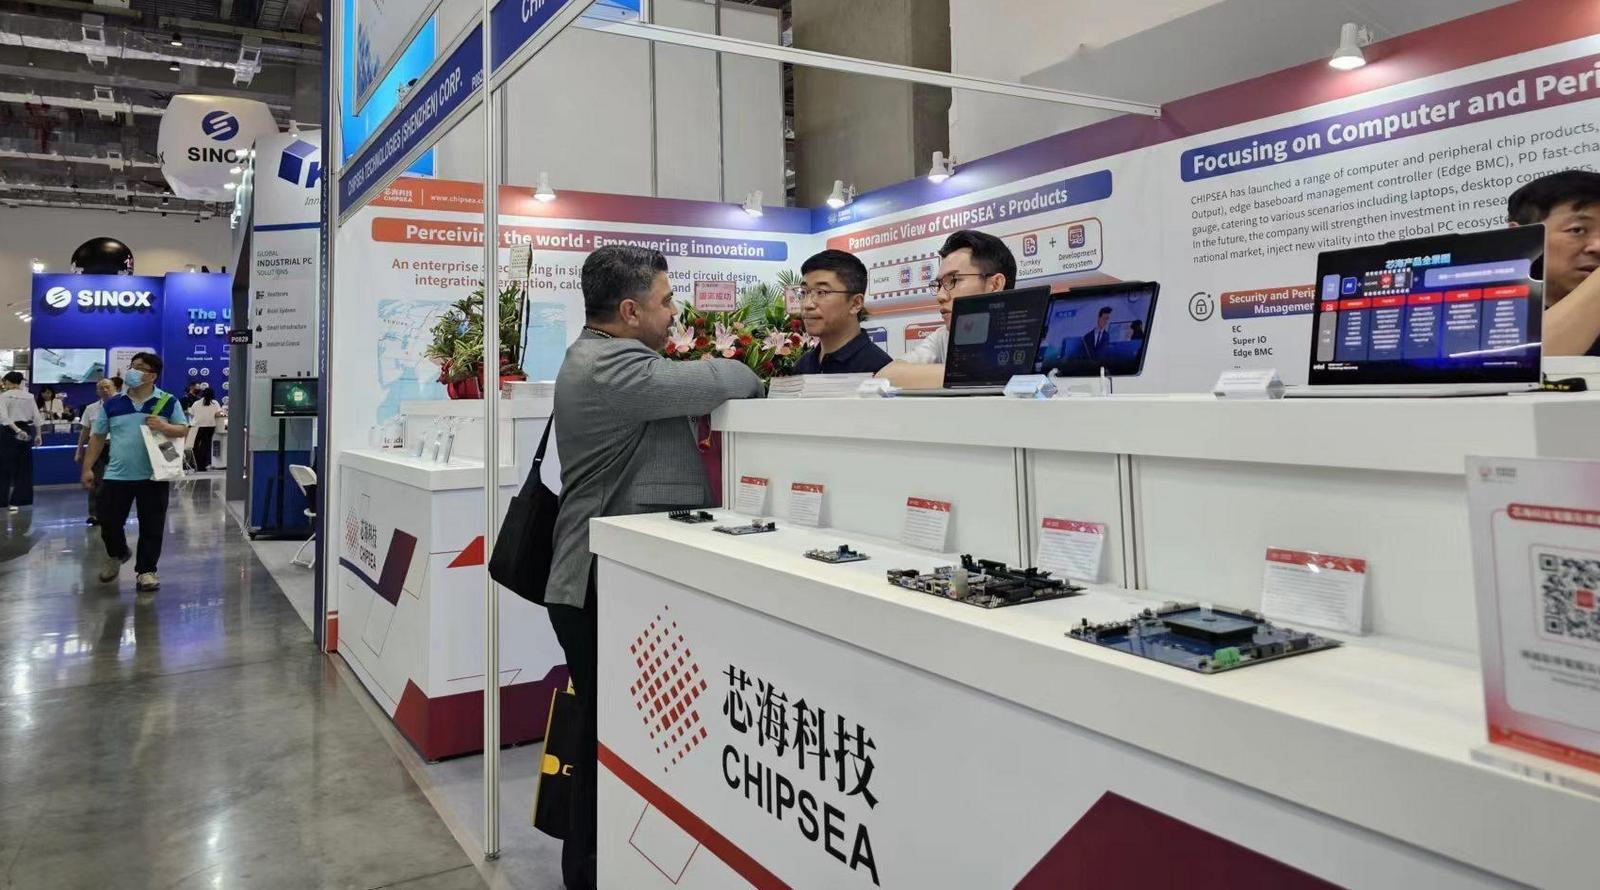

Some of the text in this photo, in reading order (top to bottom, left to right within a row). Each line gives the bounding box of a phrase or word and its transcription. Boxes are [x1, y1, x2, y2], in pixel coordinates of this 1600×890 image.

[364, 129, 400, 179] TECHNOLOGIES
[401, 91, 438, 149] (SHENZHEN)
[439, 67, 463, 106] CORP.
[1193, 141, 1288, 174] Focusing
[1292, 133, 1321, 153] on
[1327, 100, 1461, 145] Computer
[1468, 79, 1526, 115] and
[187, 146, 250, 164] SINO
[1191, 122, 1599, 205] CHIPSEA has launched a range of computer and peripheral chip products,
[1229, 202, 1252, 214] edge
[1253, 193, 1304, 209] baseboard
[1306, 181, 1374, 200] management
[1377, 170, 1433, 188] controller
[1437, 162, 1472, 180] (Edge
[1476, 155, 1514, 172] BMC),
[1519, 151, 1537, 164] PD
[1543, 142, 1600, 160] fast-cha
[1192, 225, 1220, 237] gauge,
[1221, 216, 1257, 230] catering
[1259, 216, 1269, 224] to
[1271, 210, 1305, 223] various
[1307, 202, 1354, 216] scenarios
[1356, 193, 1408, 209] including
[1411, 185, 1458, 200] laptops,
[1461, 176, 1513, 191] desktop
[848, 227, 898, 250] Panoramic
[899, 222, 926, 238] View
[928, 216, 942, 233] of
[1008, 188, 1068, 215] Products
[1192, 240, 1201, 248] In
[1202, 237, 1217, 247] the
[1218, 234, 1247, 245] future,
[1249, 231, 1264, 241] the
[1266, 226, 1309, 239] company
[1311, 221, 1328, 232] will
[1330, 213, 1387, 230] strengthen
[1390, 203, 1456, 221] investment
[1459, 200, 1470, 211] in
[504, 230, 532, 245] the
[536, 232, 583, 248] world
[691, 240, 765, 257] innovation
[1193, 251, 1228, 263] national
[1230, 246, 1265, 259] market,
[1266, 244, 1293, 257] inject
[1295, 241, 1315, 250] new
[1317, 236, 1351, 249] vitality
[1354, 234, 1375, 243] into
[1378, 228, 1396, 239] the
[1399, 222, 1434, 240] global
[1438, 221, 1455, 232] PC
[257, 257, 313, 267] INDUSTRIAL PC
[1058, 248, 1097, 261] Development
[256, 268, 289, 277] SOLUTIONS
[391, 258, 409, 270] An
[412, 260, 479, 274] enterprise
[555, 264, 566, 275] in
[1018, 267, 1043, 278] Solutions
[1062, 259, 1094, 271] ecosystem
[415, 274, 482, 289] integratin
[693, 270, 724, 281] circuit
[726, 271, 760, 283] design,
[672, 283, 691, 293] and
[77, 289, 151, 307] SINOX
[1229, 291, 1267, 304] Security
[1270, 290, 1290, 300] and
[188, 308, 217, 320] The
[188, 323, 210, 335] for
[1232, 325, 1242, 333] EC
[1232, 335, 1267, 346] Super IO
[1233, 347, 1273, 358] Edge BMC
[722, 664, 880, 810] 芯海科技
[722, 744, 880, 887] CHIPSEA
